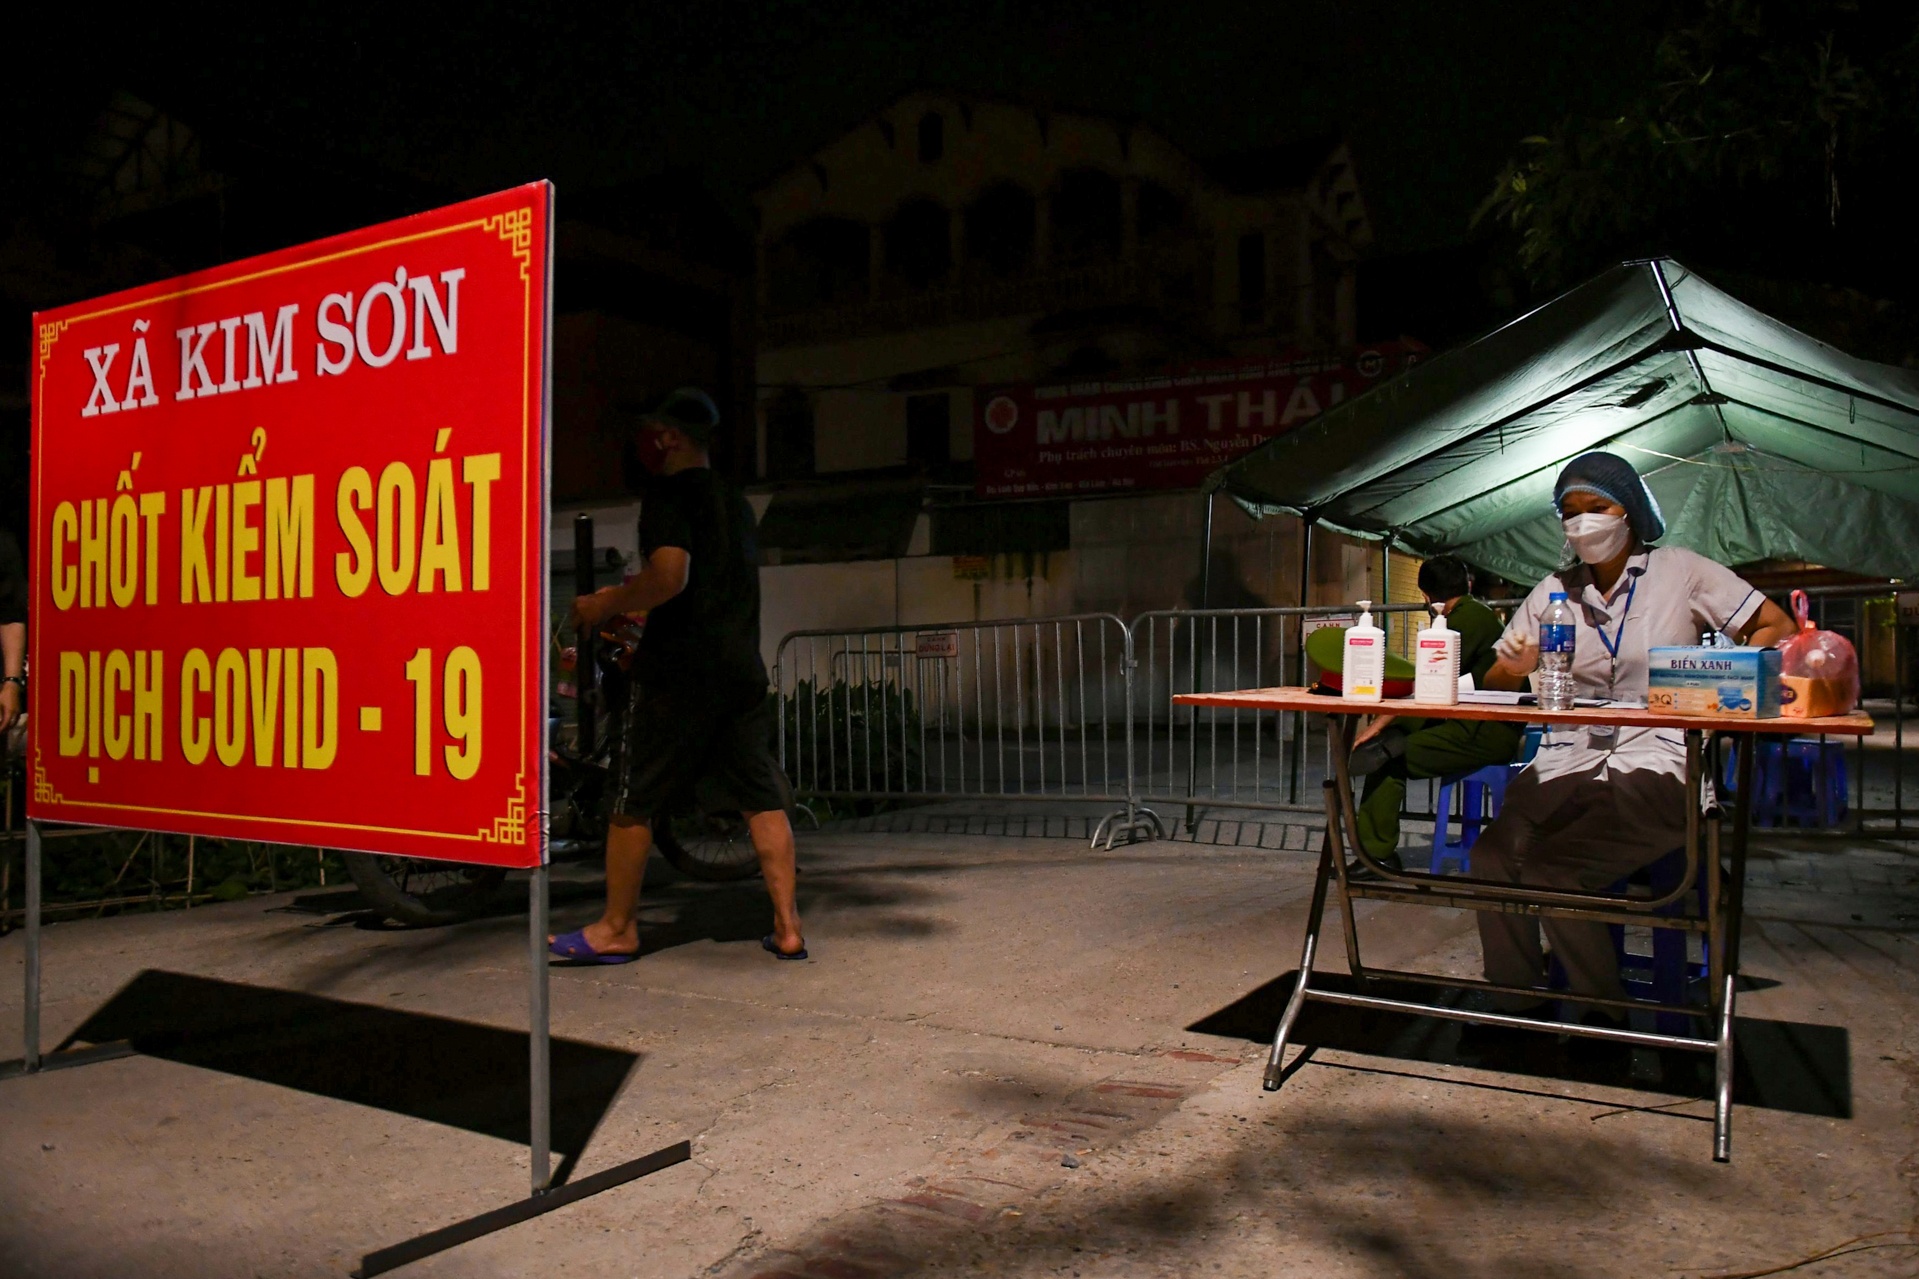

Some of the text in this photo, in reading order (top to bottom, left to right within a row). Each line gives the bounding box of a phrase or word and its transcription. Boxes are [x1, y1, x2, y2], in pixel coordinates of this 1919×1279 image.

[81, 265, 466, 418] XÃ KIM SƠN
[1036, 399, 1181, 445] MINH
[51, 427, 501, 611] CHỐT KIỂM SOÁT
[59, 648, 165, 784] DỊCH
[181, 647, 339, 771] COVID
[406, 646, 484, 781] 19
[1700, 661, 1732, 671] XANH
